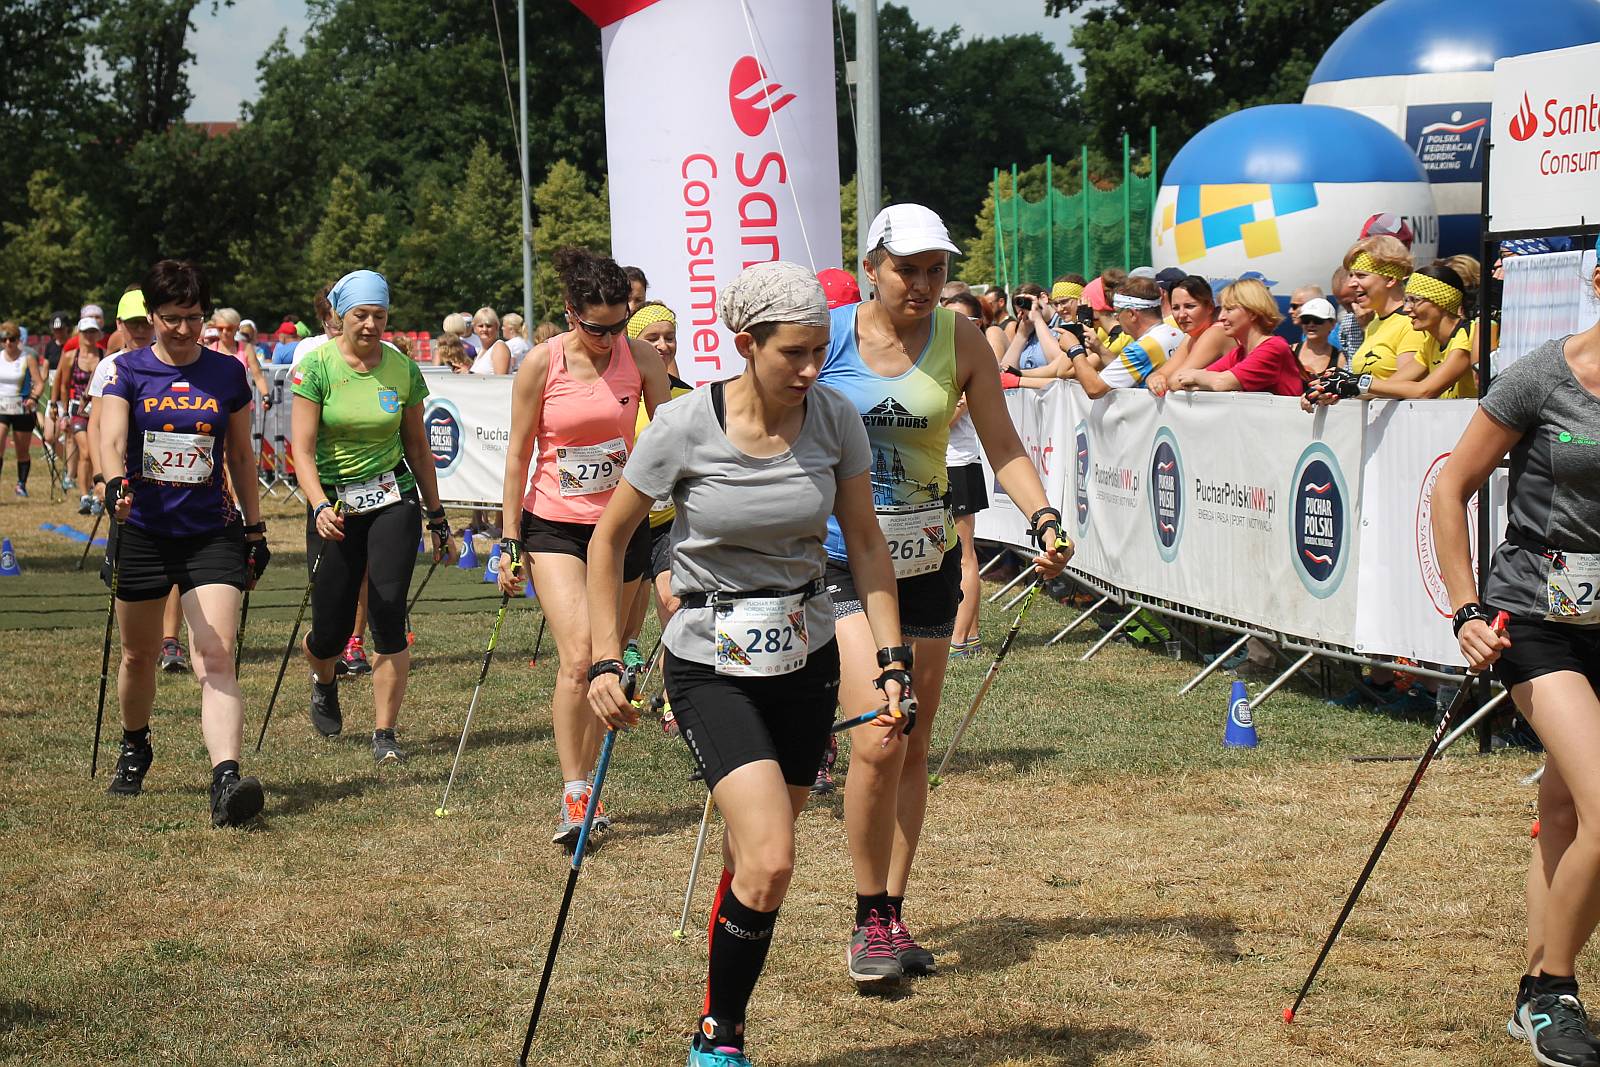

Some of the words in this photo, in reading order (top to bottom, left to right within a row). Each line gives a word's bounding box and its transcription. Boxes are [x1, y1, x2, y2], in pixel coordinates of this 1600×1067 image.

[1542, 93, 1600, 138] Sant
[1424, 142, 1473, 153] FEDERACJA
[1426, 134, 1461, 144] POLSKA
[1422, 152, 1457, 161] NORDIC
[734, 151, 789, 269] San
[681, 153, 721, 371] Consumer
[143, 396, 219, 413] PASJA
[431, 425, 452, 436] PUCHAR
[430, 435, 452, 447] POLSKI
[162, 451, 198, 468] 217
[577, 461, 613, 481] 279
[355, 491, 386, 509] 258
[1195, 478, 1276, 519] PucharPolskiNW.pl
[1305, 496, 1333, 517] PUCHAR
[1304, 514, 1334, 538] POLSKI
[887, 537, 926, 560] 261
[746, 626, 793, 654] 282
